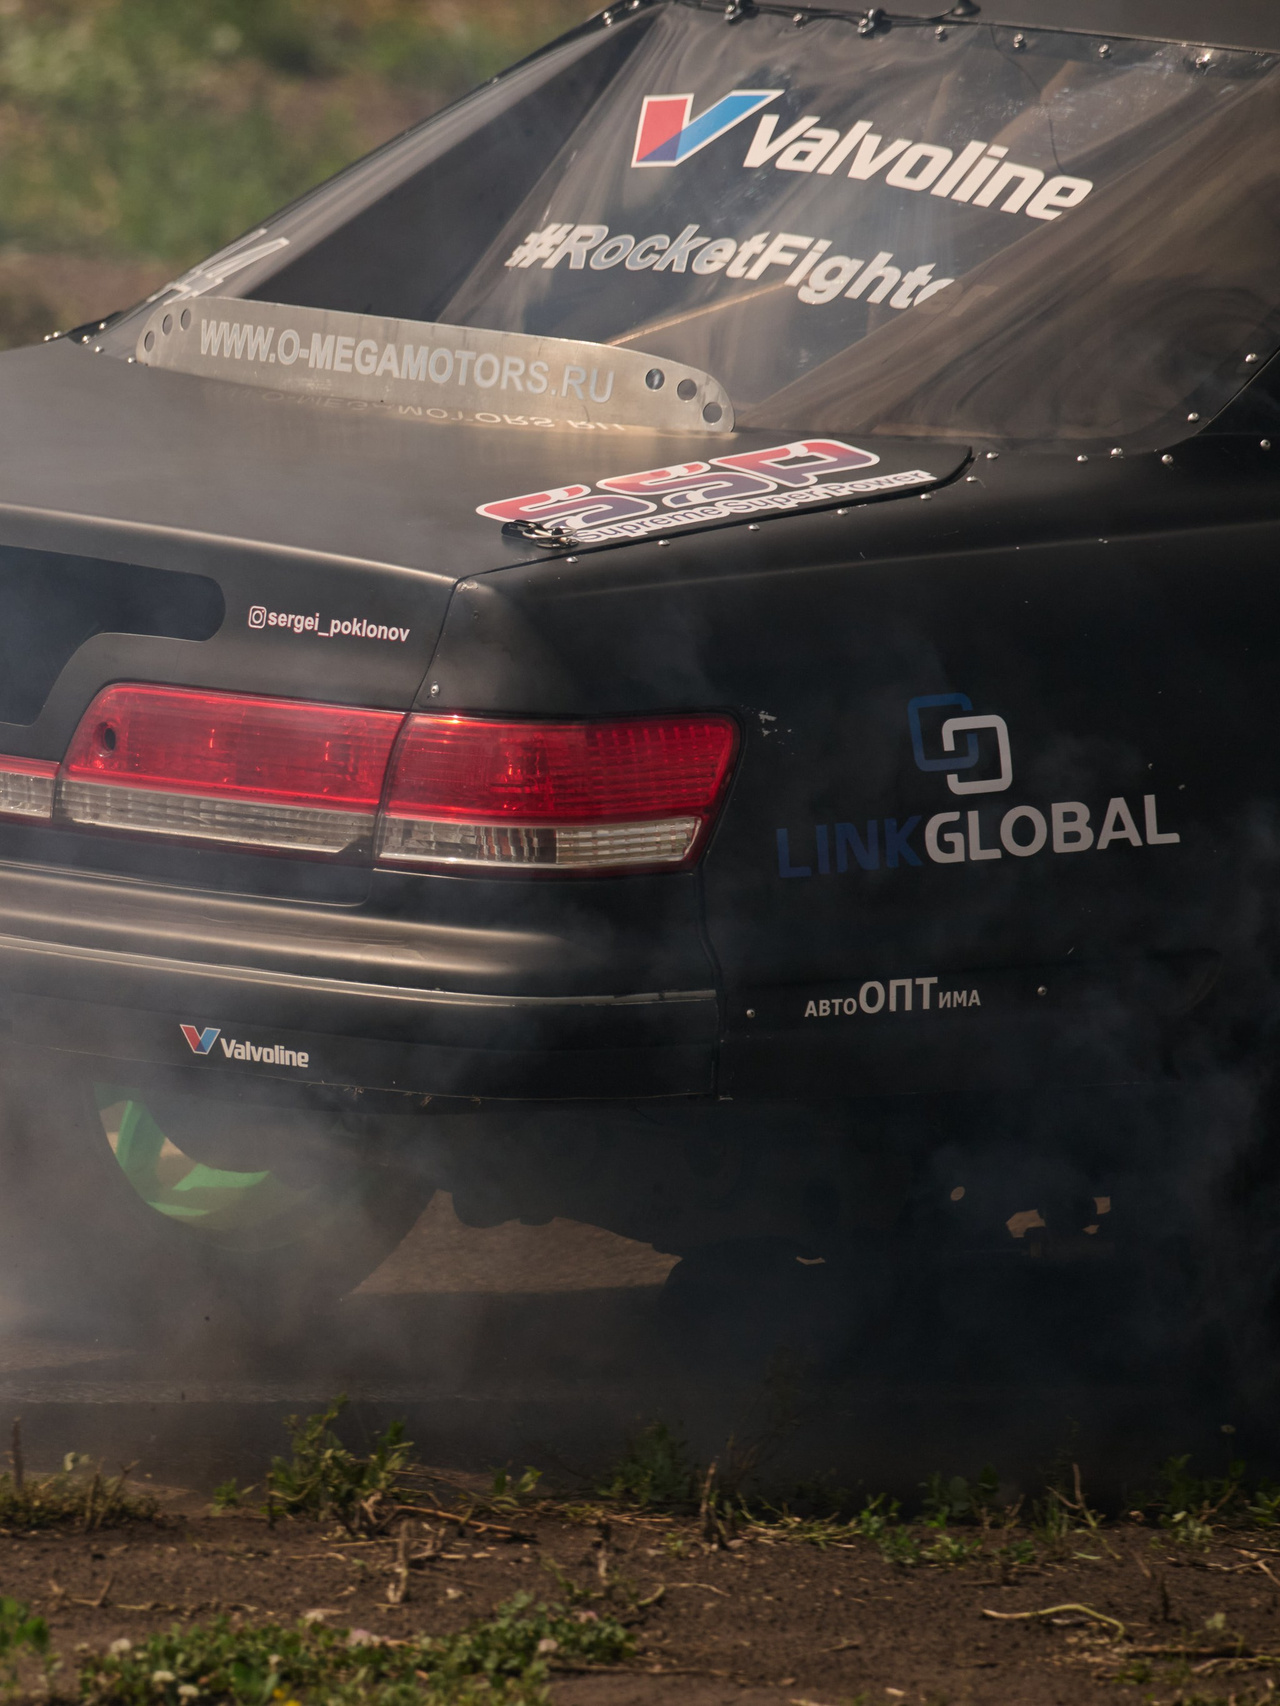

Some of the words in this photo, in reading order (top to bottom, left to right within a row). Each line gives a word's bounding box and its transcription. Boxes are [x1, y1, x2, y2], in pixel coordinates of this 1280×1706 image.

[743, 113, 1094, 221] Valvoline
[200, 318, 616, 404] WWW.O-MEGAMOTORS.RU
[574, 506, 724, 543] Supreme
[723, 487, 824, 512] Super
[828, 470, 929, 496] Power
[267, 611, 410, 642] sergei_poklonov
[220, 1038, 309, 1068] Valvoline
